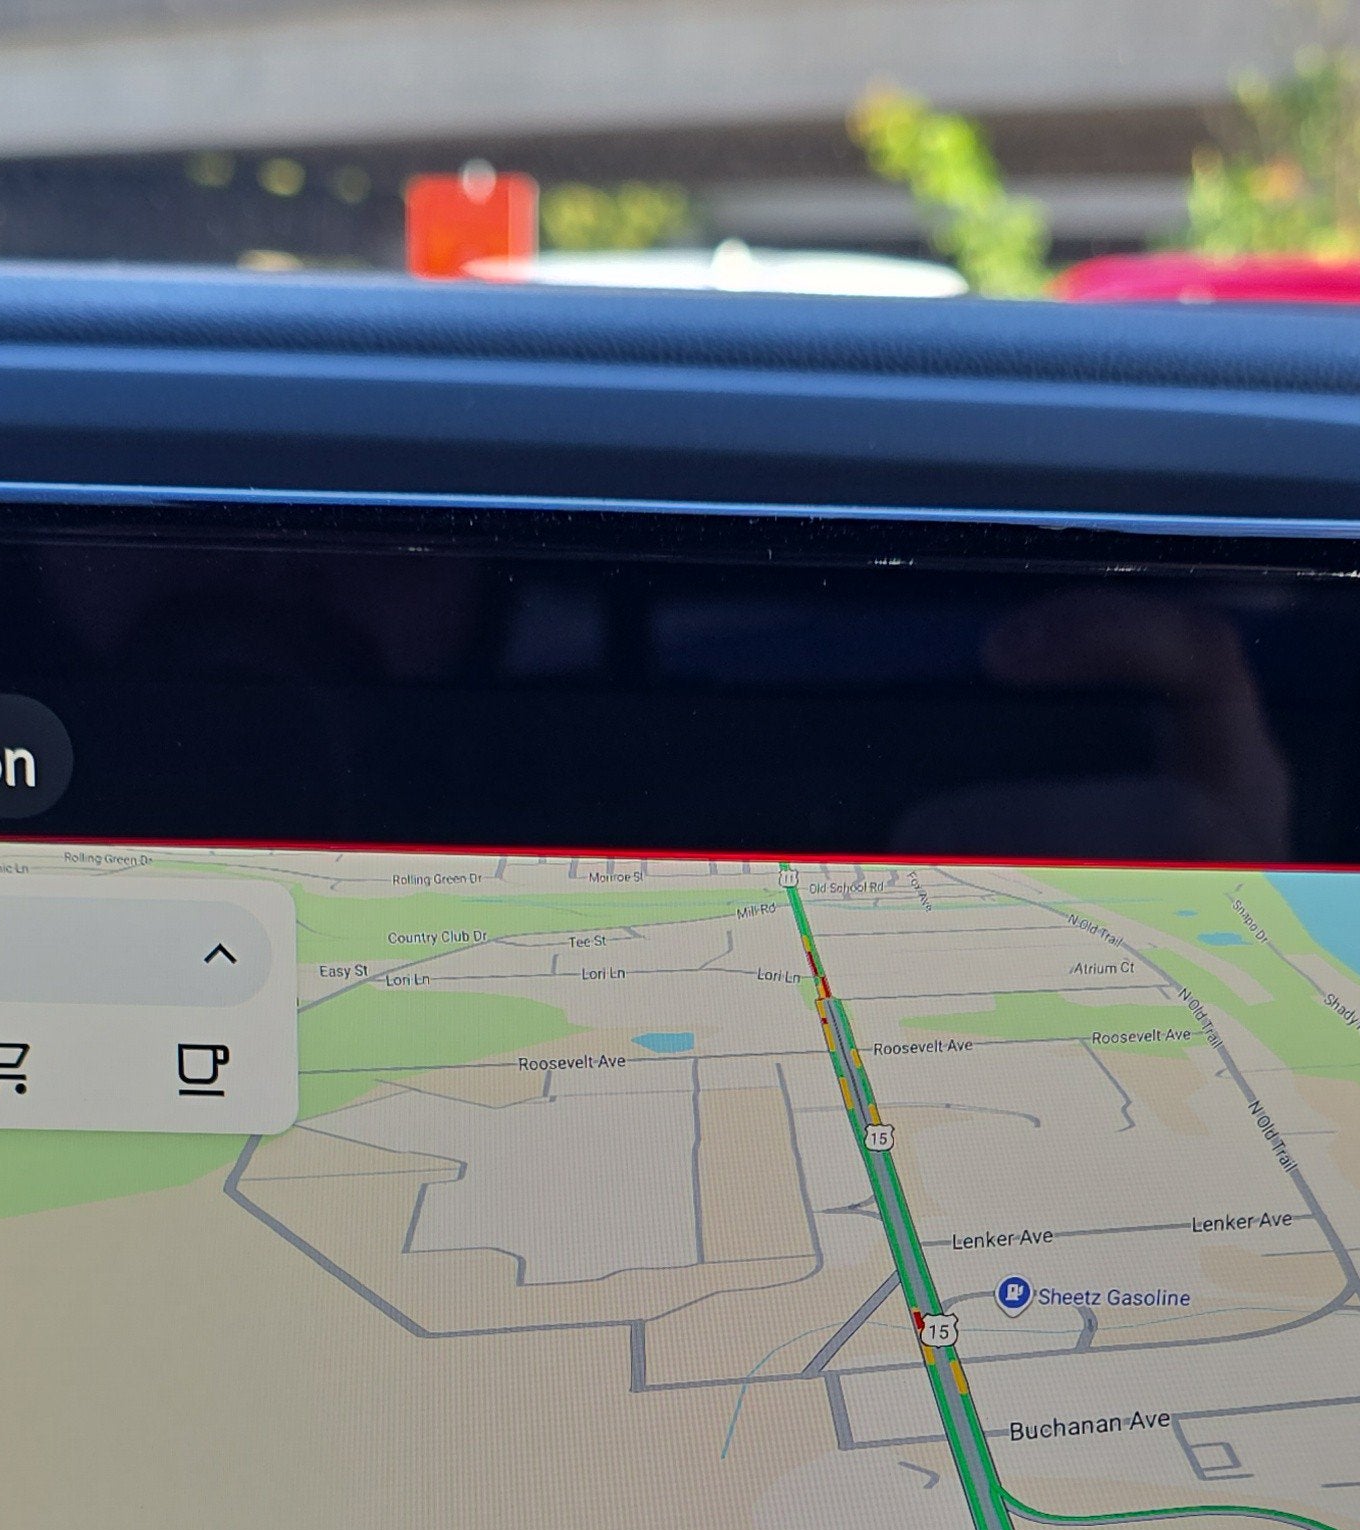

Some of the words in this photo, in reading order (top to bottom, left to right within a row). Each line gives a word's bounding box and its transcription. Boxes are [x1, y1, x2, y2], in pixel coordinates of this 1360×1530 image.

[64, 851, 102, 866] Rolling
[104, 853, 137, 866] Green
[15, 863, 29, 874] Ln
[392, 873, 431, 887] Rolling
[433, 873, 467, 885] Green
[469, 873, 483, 884] Dr
[589, 872, 631, 884] Monroe
[633, 871, 644, 883] St
[809, 882, 828, 894] Old
[830, 881, 868, 894] School
[870, 881, 885, 893] Rd
[736, 906, 756, 921] Mill
[757, 902, 777, 917] Rd
[1231, 899, 1258, 934] Snapo
[1255, 926, 1270, 944] Dr
[388, 931, 438, 946] Country
[441, 930, 471, 944] Club
[474, 930, 488, 942] Dr
[1067, 913, 1080, 927] N
[1079, 918, 1099, 935] Old
[1098, 926, 1124, 948] Trail
[593, 934, 607, 947] St
[319, 965, 351, 979] Easy
[354, 964, 369, 977] St
[582, 967, 607, 980] Lori
[609, 967, 626, 979] Ln
[757, 968, 780, 982] Lori
[783, 970, 801, 984] Ln
[1073, 962, 1118, 975] Atrium
[1120, 961, 1135, 974] Ct
[386, 974, 411, 987] Lori
[414, 973, 431, 986] Ln
[1178, 987, 1192, 1001] N
[1187, 998, 1208, 1023] Old
[1324, 993, 1358, 1027] Shady
[1091, 1028, 1162, 1045] Roosevelt
[1164, 1028, 1191, 1041] Ave
[1196, 1020, 1223, 1050] Trail
[873, 1040, 942, 1056] Roosevelt
[944, 1039, 974, 1052] Ave
[518, 1055, 594, 1072] Roosevelt
[597, 1054, 627, 1068] Ave
[870, 1131, 888, 1146] 15
[1247, 1100, 1264, 1117] N
[1256, 1115, 1277, 1142] Old
[1270, 1139, 1298, 1173] Trail
[1192, 1213, 1254, 1233] Lenker
[1258, 1212, 1293, 1229] Ave
[952, 1230, 1015, 1250] Lenker
[1020, 1229, 1054, 1246] Ave
[1039, 1287, 1102, 1307] Sheetz
[1107, 1288, 1191, 1307] Gasoline
[928, 1324, 950, 1341] 15
[1009, 1416, 1122, 1442] Buchanan
[1129, 1411, 1171, 1431] Ave
